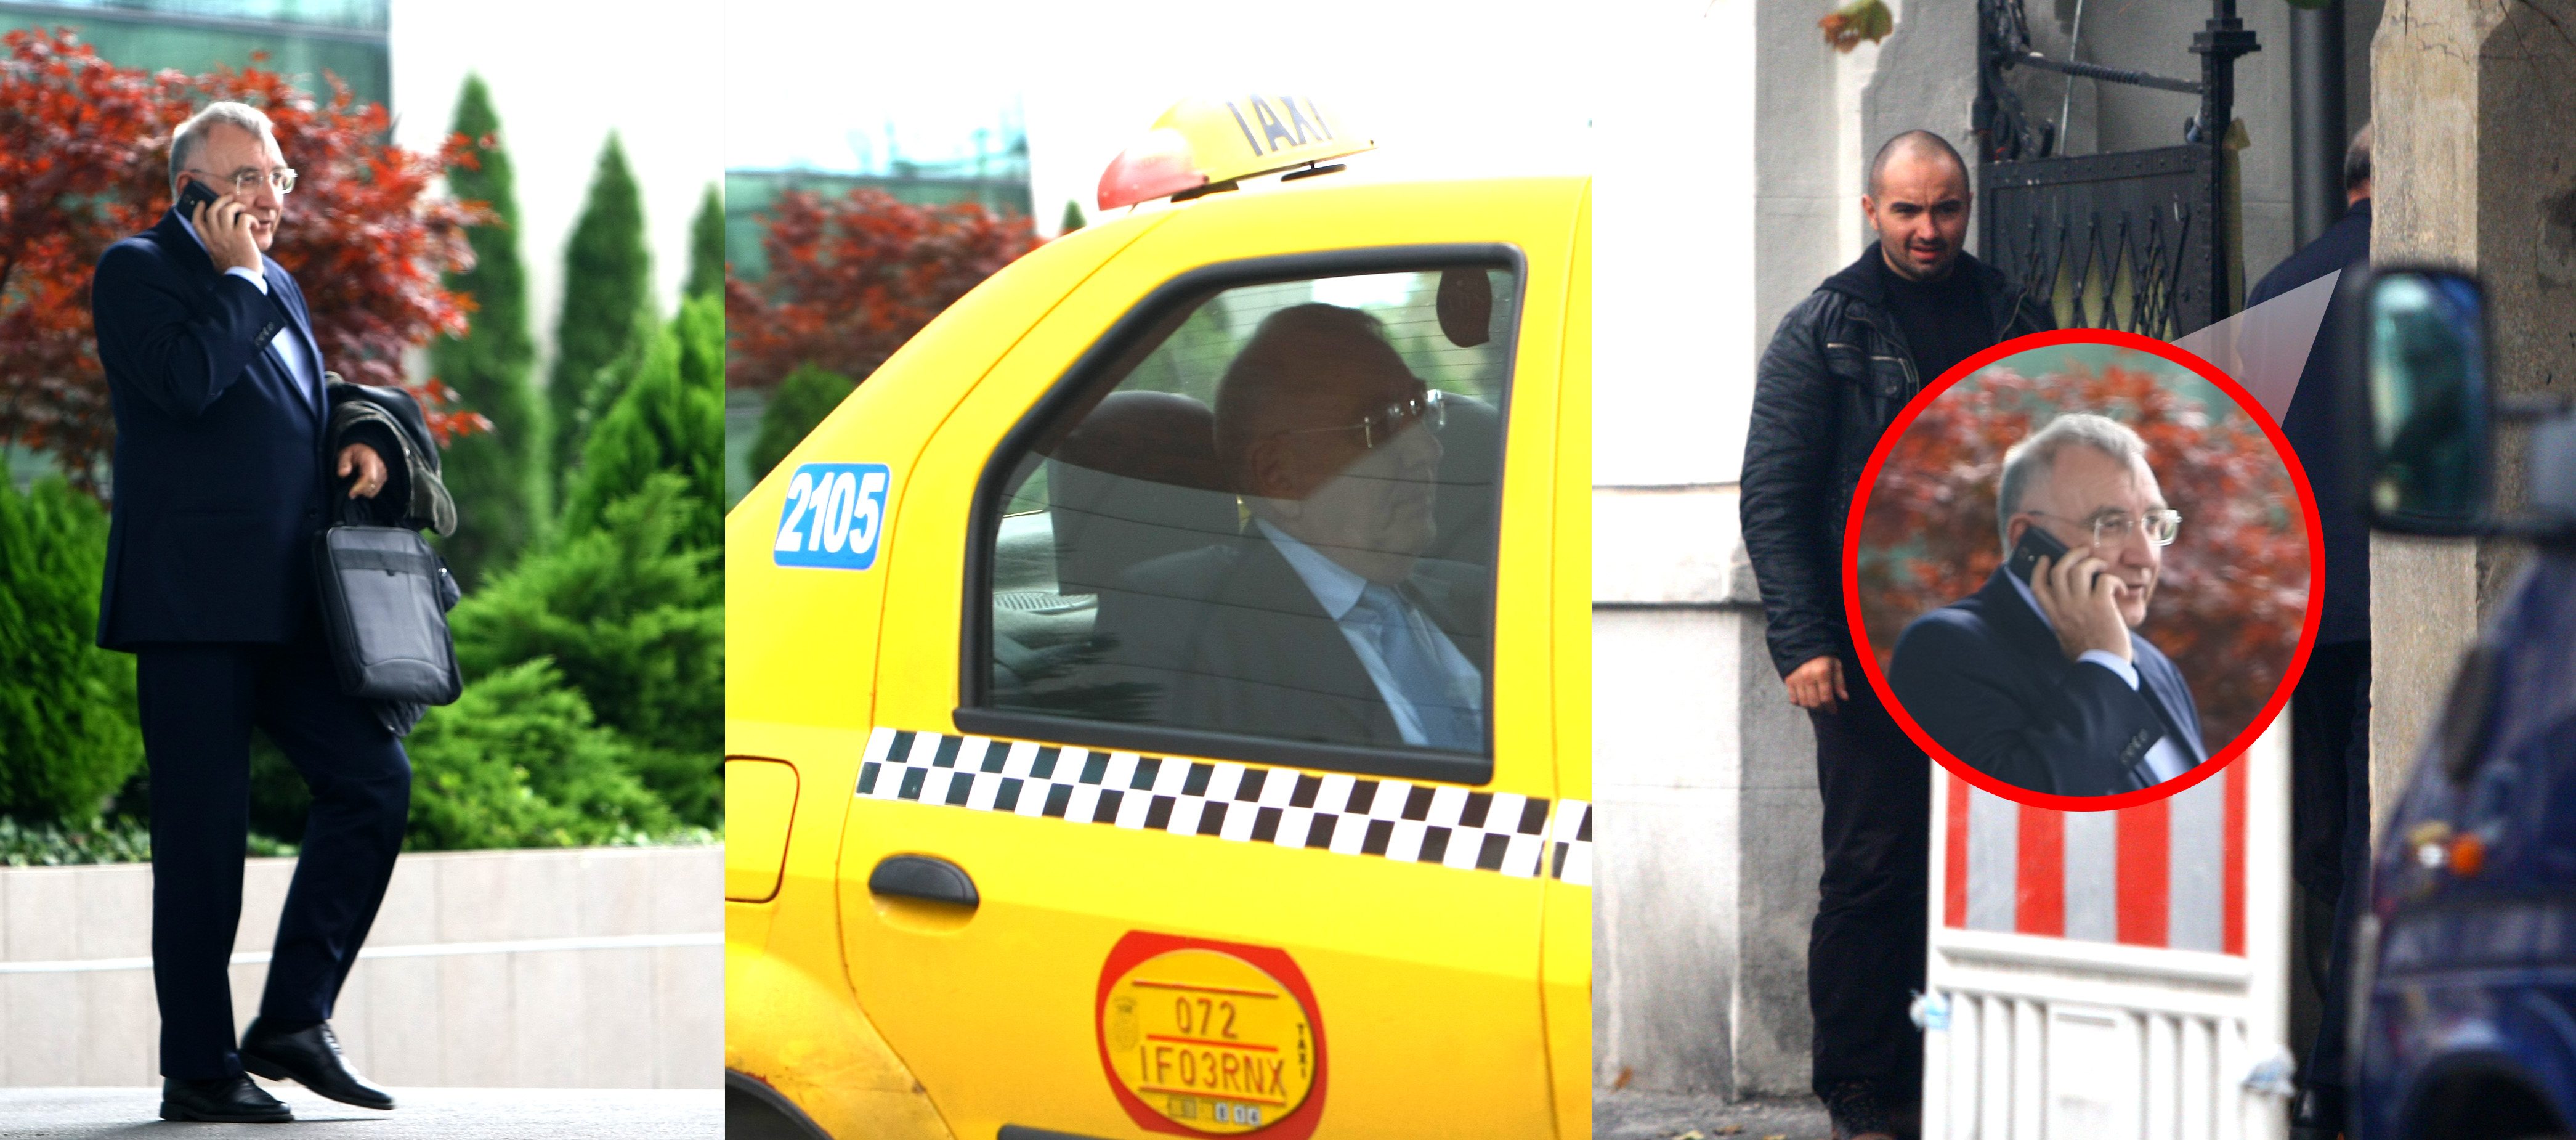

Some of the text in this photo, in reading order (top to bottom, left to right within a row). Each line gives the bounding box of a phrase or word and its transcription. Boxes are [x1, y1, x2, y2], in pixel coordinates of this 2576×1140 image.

[774, 471, 886, 554] 2105
[1174, 996, 1238, 1039] 072
[1296, 1023, 1307, 1080] TAXI
